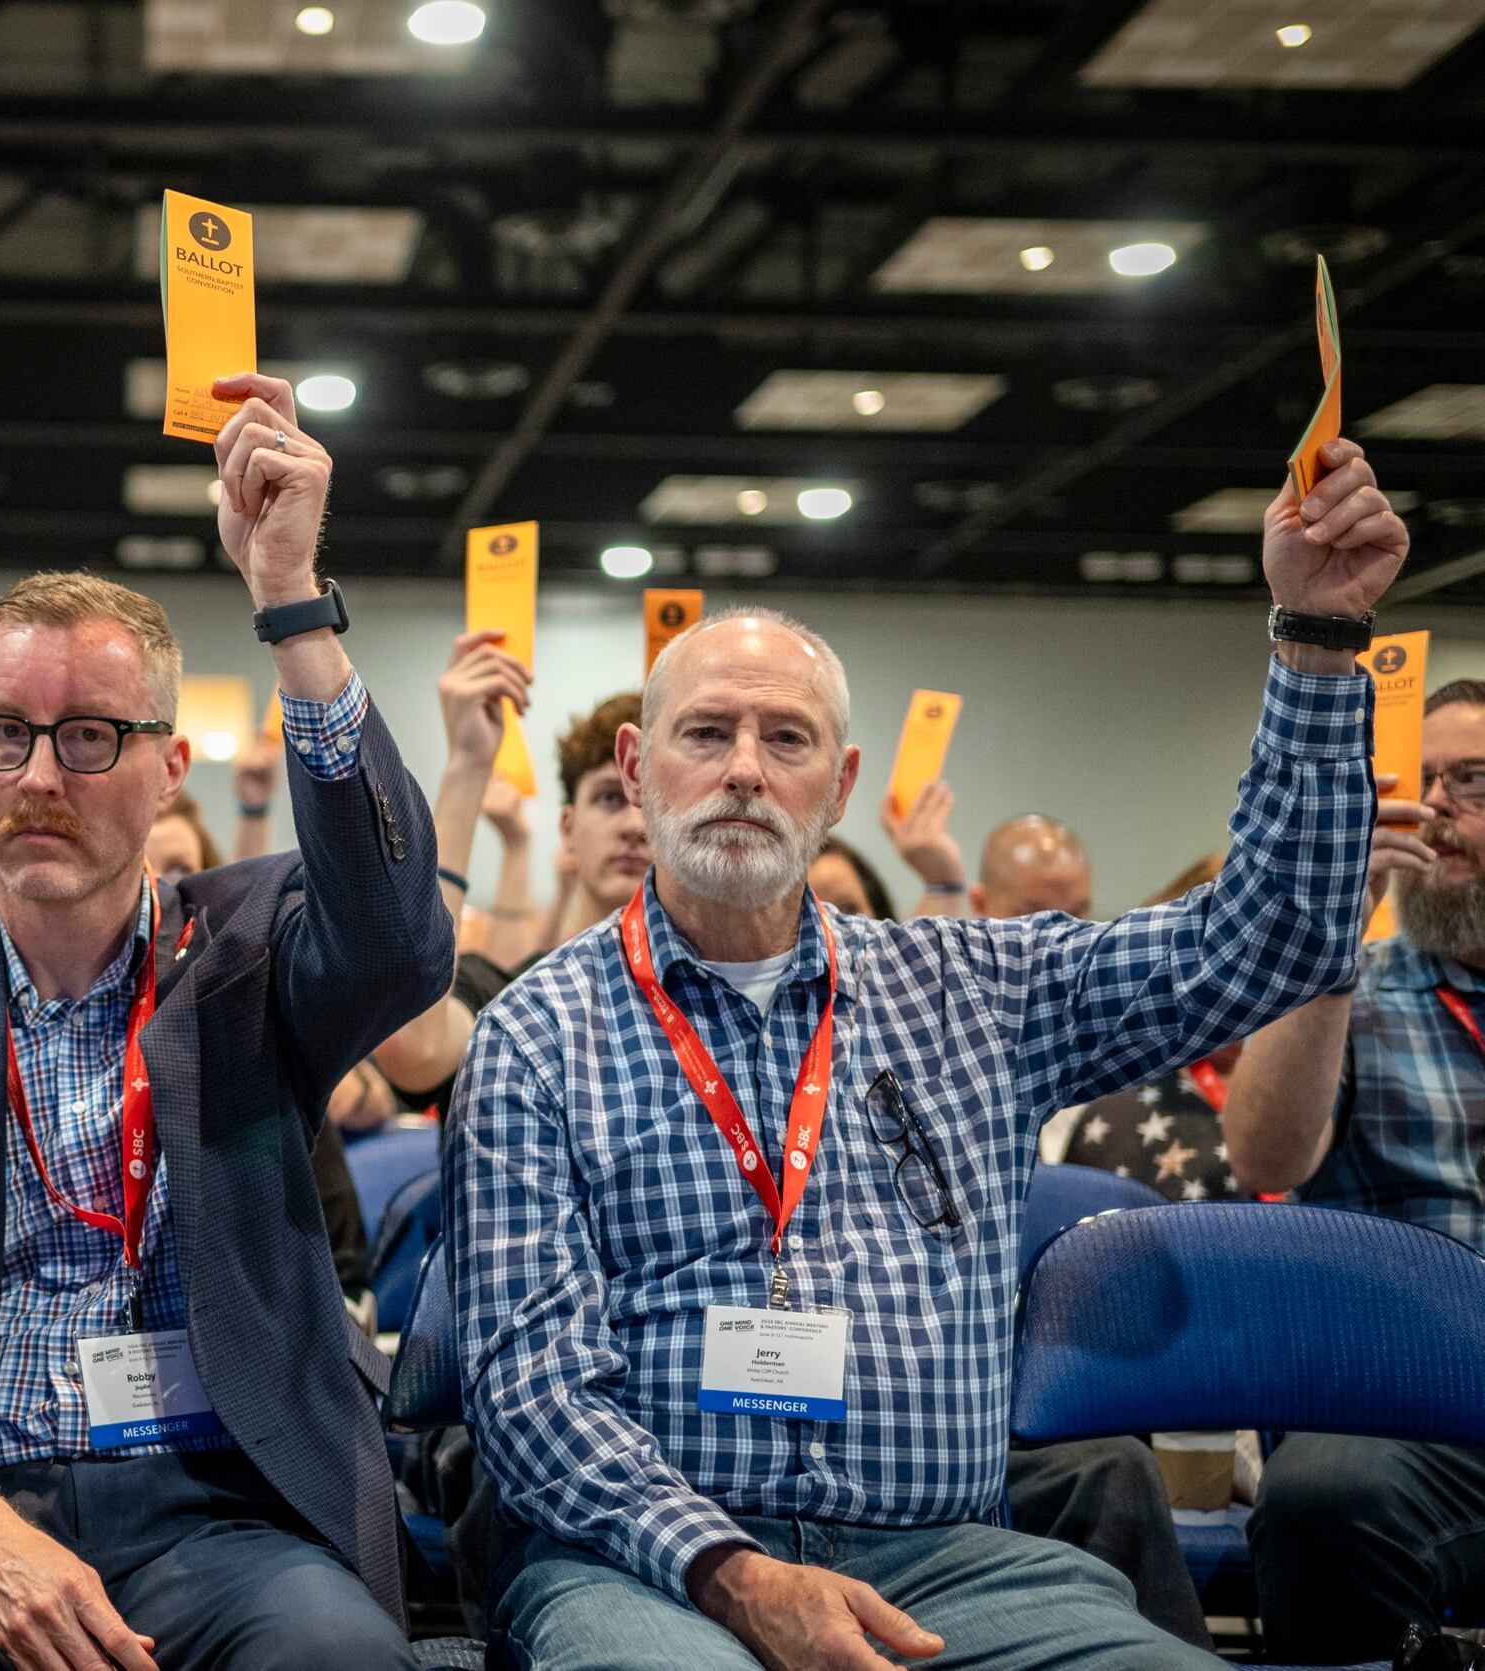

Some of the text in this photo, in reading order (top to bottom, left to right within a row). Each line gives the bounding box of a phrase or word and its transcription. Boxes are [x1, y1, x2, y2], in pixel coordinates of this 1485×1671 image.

[176, 247, 244, 277] BALLOT
[177, 266, 244, 290] SOUTHERN BAPTIST
[186, 276, 234, 295] CONVENTION
[133, 1128, 144, 1157] SBC
[730, 1123, 748, 1151] SBC
[797, 1124, 812, 1150] SBC
[106, 1352, 123, 1360] VOICE
[756, 1348, 781, 1360] Jerry
[127, 1372, 156, 1383] Robby
[732, 1398, 808, 1412] MESSENGER
[123, 1420, 190, 1438] MESSENGER
